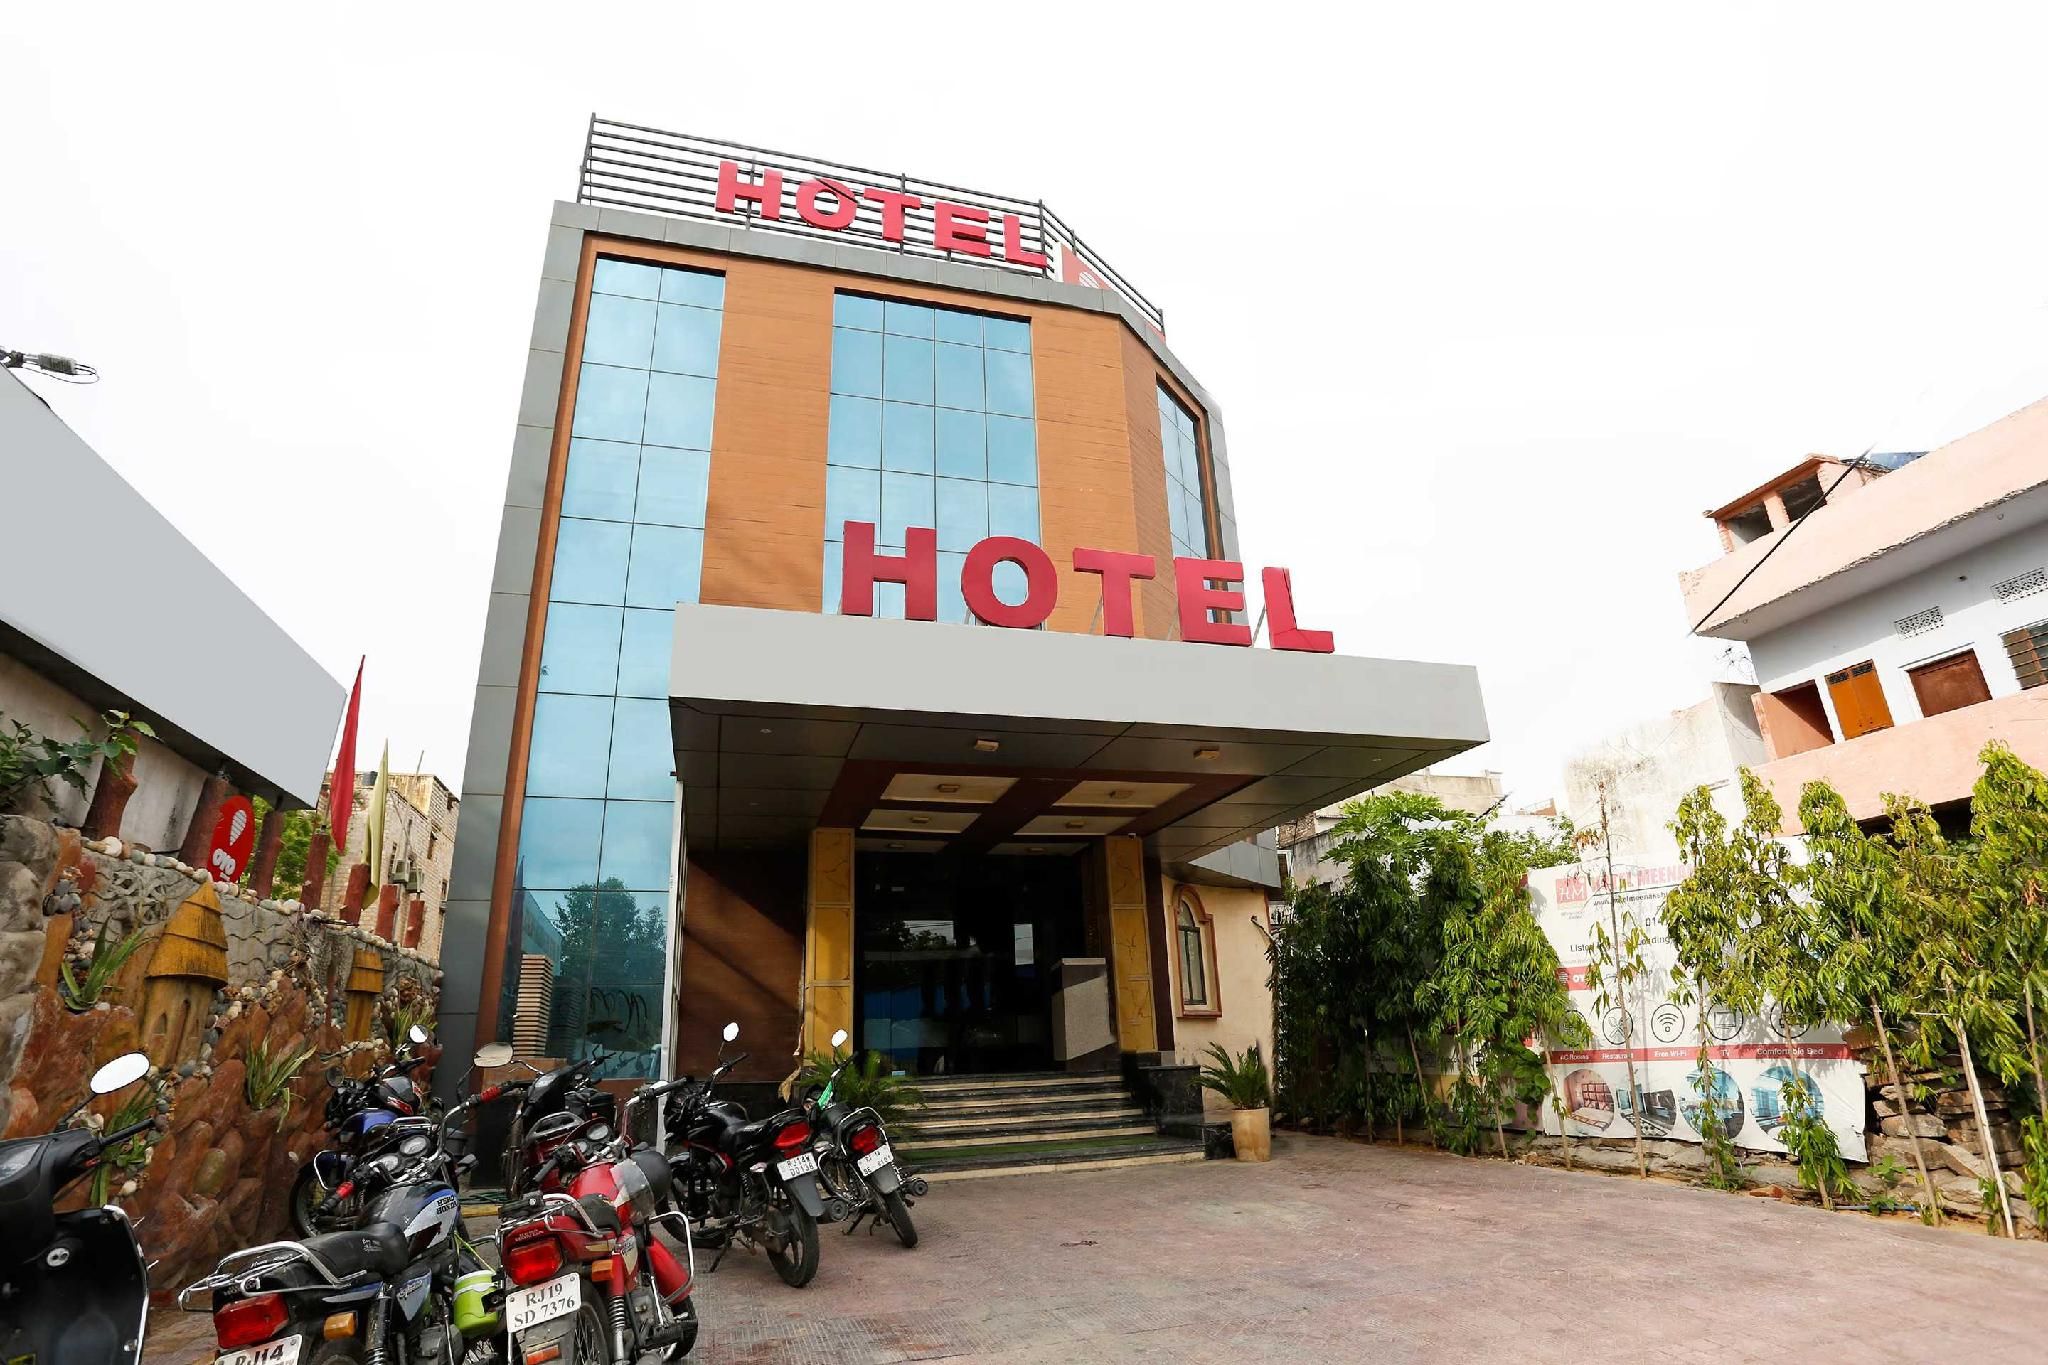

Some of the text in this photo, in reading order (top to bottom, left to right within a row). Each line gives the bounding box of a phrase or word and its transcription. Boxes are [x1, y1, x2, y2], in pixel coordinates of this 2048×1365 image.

[714, 159, 1048, 269] HOTEL
[840, 519, 1335, 654] HOTEL
[1602, 1052, 1634, 1060] Restaurat
[1654, 1050, 1669, 1058] Free
[1757, 1047, 1804, 1056] Comfortble
[514, 1296, 576, 1328] SD 7376
